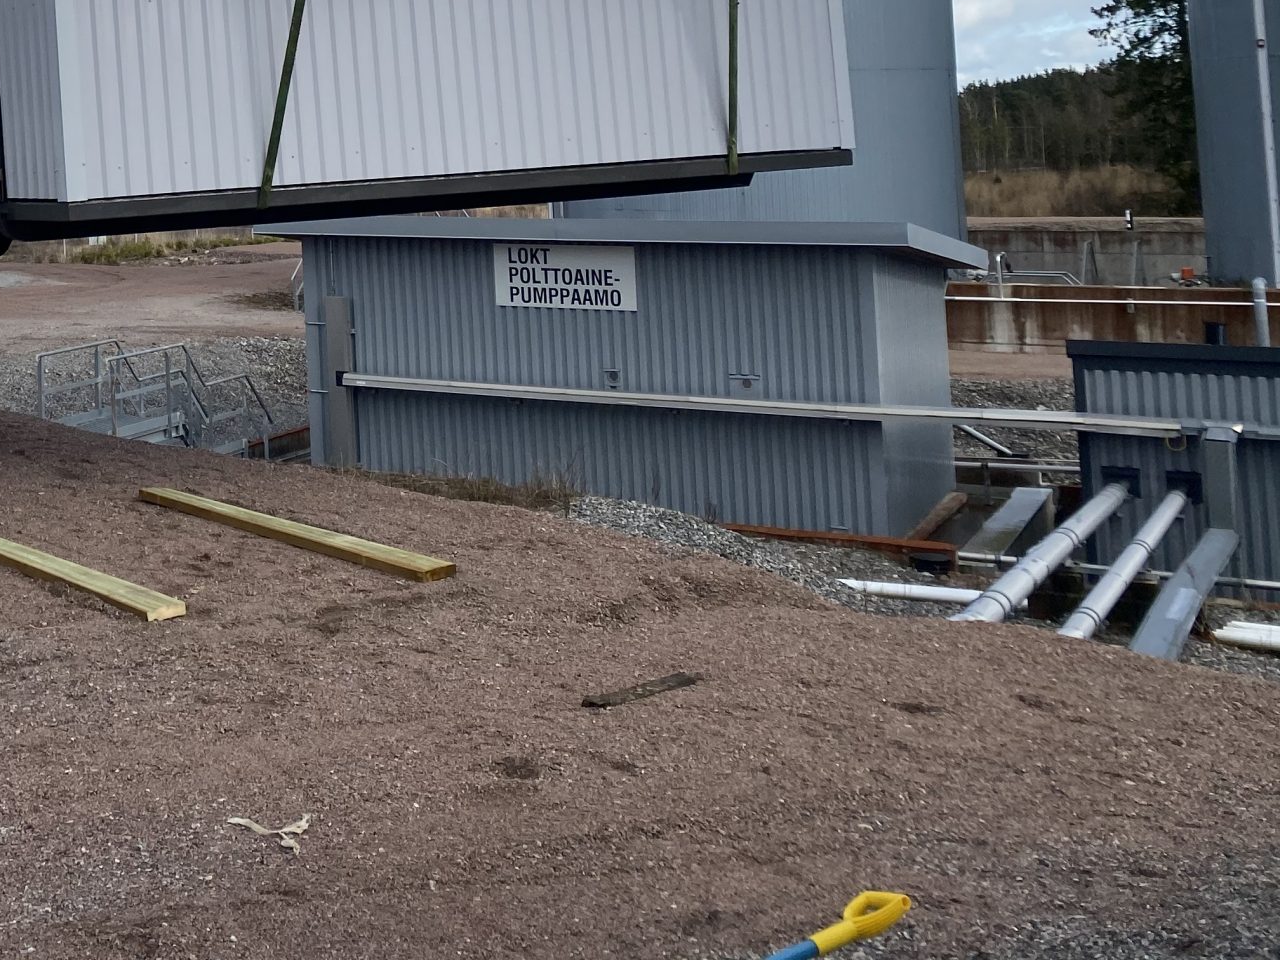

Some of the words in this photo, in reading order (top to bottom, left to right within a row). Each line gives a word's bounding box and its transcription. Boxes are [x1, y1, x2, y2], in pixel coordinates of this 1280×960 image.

[507, 247, 550, 265] LOKT
[508, 266, 621, 286] POLTTOAINE-
[510, 286, 622, 307] PUMPPAAMO
